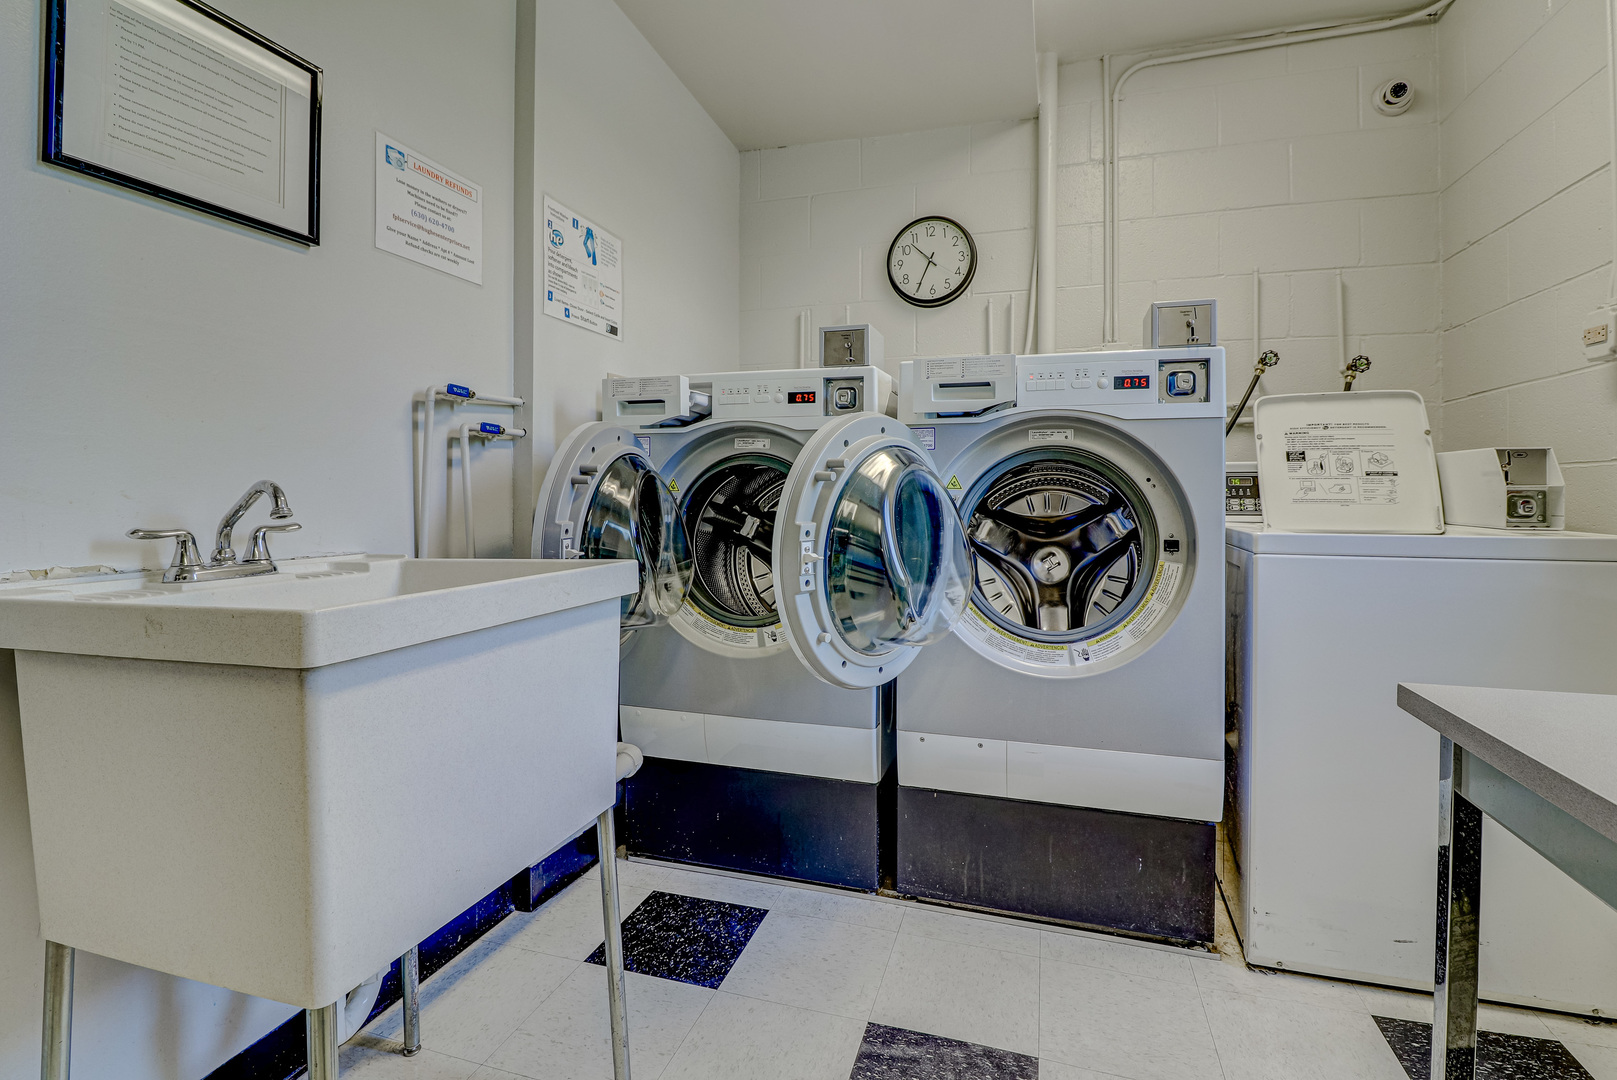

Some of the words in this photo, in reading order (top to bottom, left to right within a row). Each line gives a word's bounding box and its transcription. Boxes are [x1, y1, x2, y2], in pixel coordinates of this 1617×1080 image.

[413, 163, 443, 183] LAUNDRY
[445, 179, 472, 198] REFUNDS
[411, 208, 427, 223] (630)
[428, 216, 454, 233] 620-4700
[926, 226, 935, 237] 12
[943, 228, 946, 238] 1
[550, 231, 562, 247] he
[912, 233, 918, 244] 11
[952, 236, 959, 246] 2
[901, 245, 911, 256] 10
[958, 251, 965, 262] 3
[897, 260, 903, 270] 9
[955, 266, 961, 276] 4
[903, 274, 909, 284] 8
[944, 278, 950, 289] 5
[916, 282, 921, 293] 7
[930, 284, 936, 294] 6
